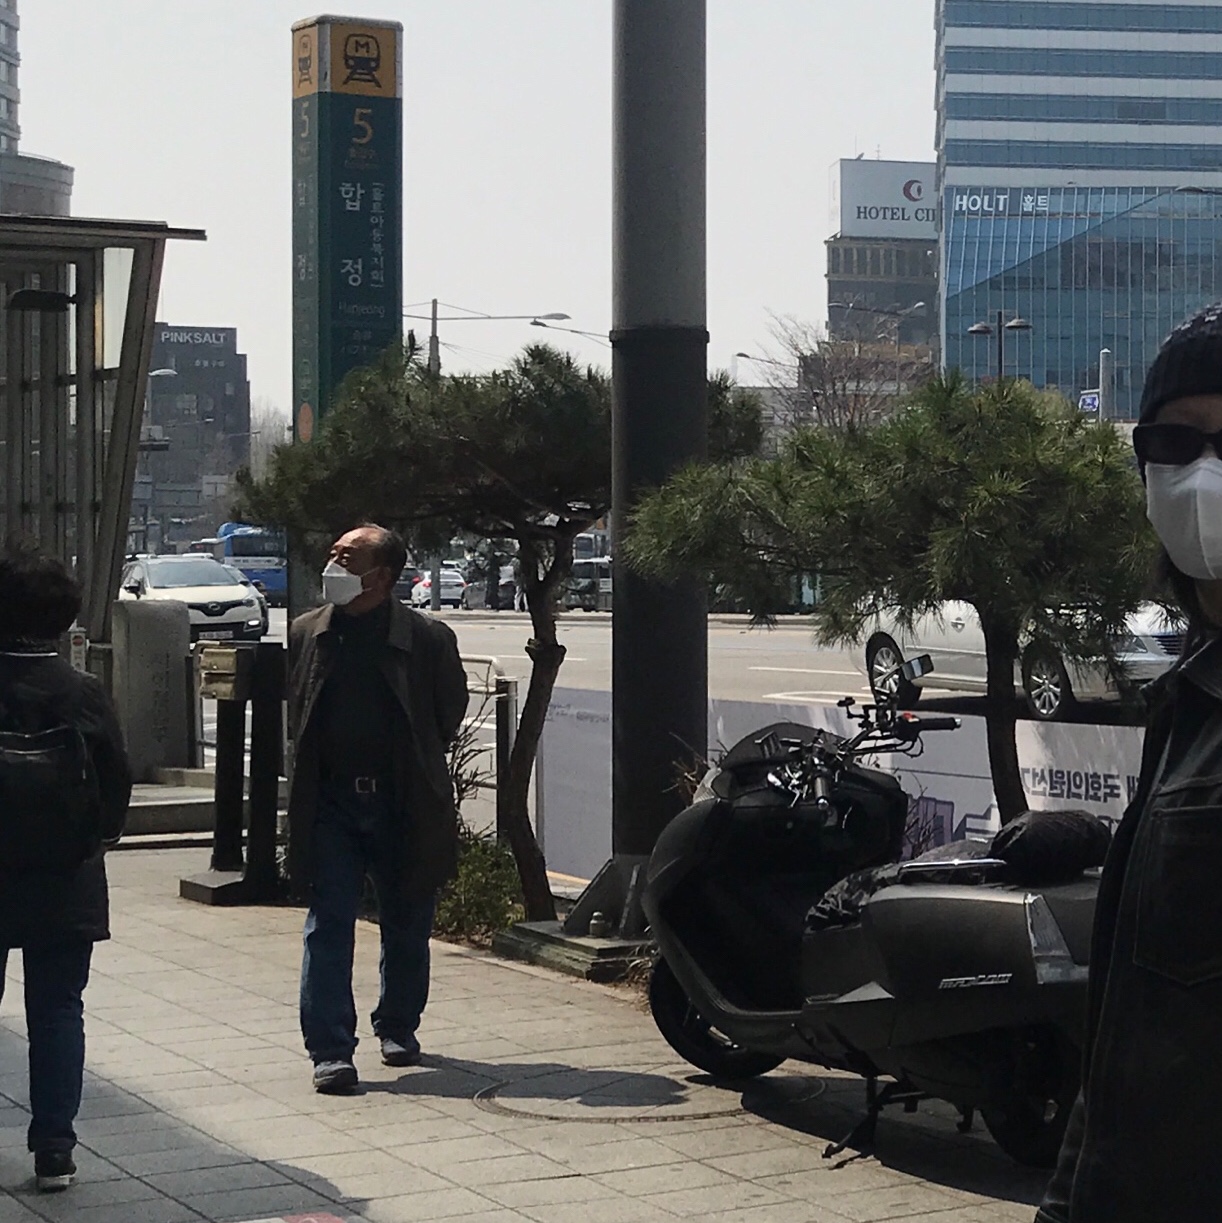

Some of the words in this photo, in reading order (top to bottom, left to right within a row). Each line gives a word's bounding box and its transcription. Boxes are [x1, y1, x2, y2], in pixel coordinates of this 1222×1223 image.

[351, 107, 374, 144] 5
[954, 194, 1008, 212] HOLT
[1022, 194, 1048, 212] 홀트
[856, 205, 911, 222] HOTEL
[161, 331, 226, 344] PINKSALT
